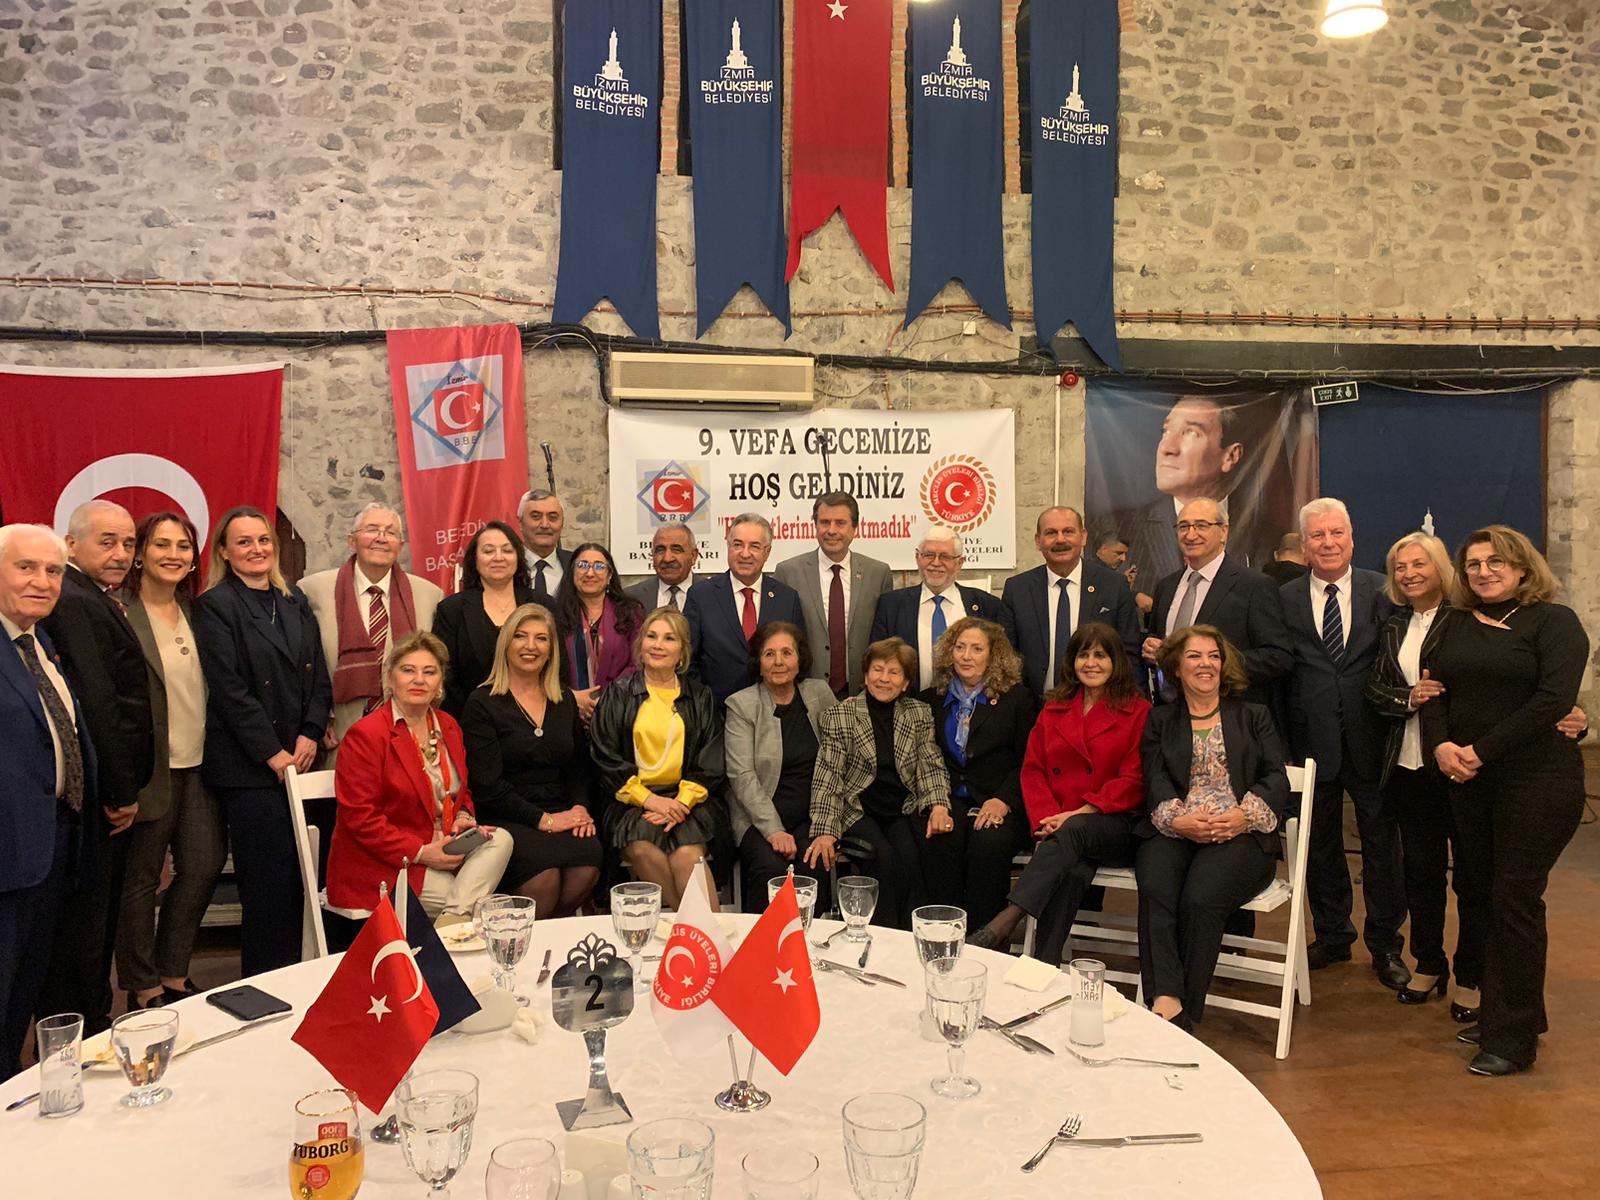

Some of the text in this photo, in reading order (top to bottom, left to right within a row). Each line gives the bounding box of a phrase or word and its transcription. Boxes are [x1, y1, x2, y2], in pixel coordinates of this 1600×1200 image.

[701, 79, 774, 93] BÜYÜKŞEHİR
[921, 72, 991, 91] BÜYÜKŞEHİR
[573, 85, 649, 108] BÜYÜKŞEHİR
[1041, 116, 1110, 135] BÜYÜKŞEHİR
[699, 421, 932, 456] 9. VEFA GECEMİZE
[729, 465, 906, 507] HOŞ GELDİNİZ
[584, 974, 605, 1012] 2
[293, 1139, 349, 1159] TUBORG
